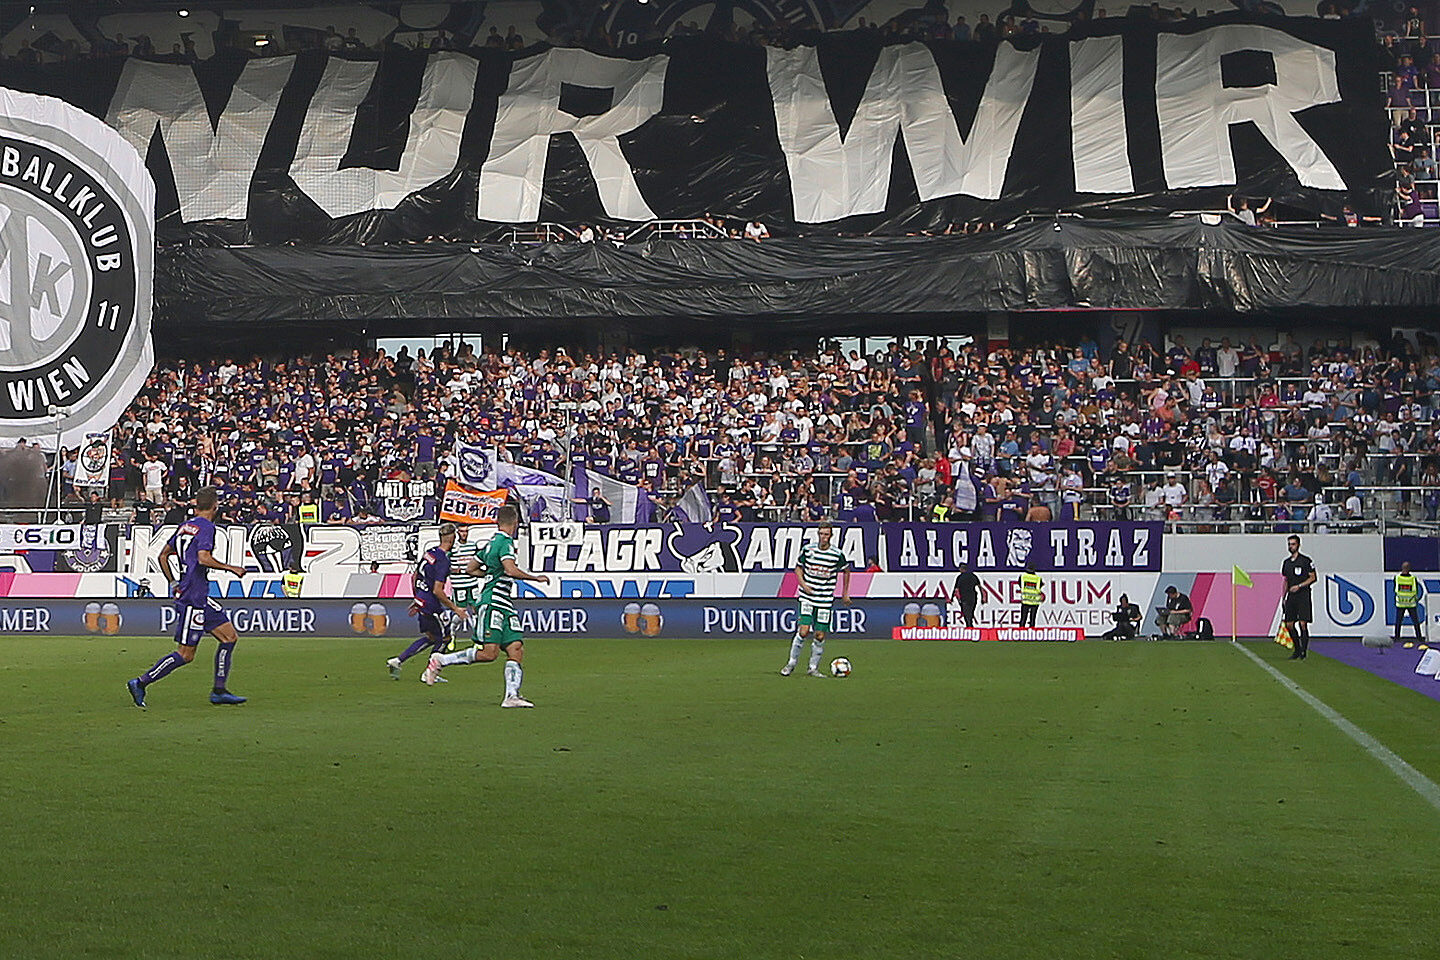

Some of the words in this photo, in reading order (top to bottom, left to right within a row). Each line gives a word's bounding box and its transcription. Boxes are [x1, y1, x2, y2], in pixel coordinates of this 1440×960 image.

[105, 47, 668, 223] NUR
[765, 24, 1347, 223] WIR
[7, 355, 91, 412] WIEN
[375, 479, 403, 497] ANTI
[899, 528, 995, 568] ALCA
[1050, 528, 1150, 567] TRAZ
[1041, 609, 1114, 626] WATER
[900, 627, 981, 642] wienholding
[996, 627, 1077, 643] wienholding
